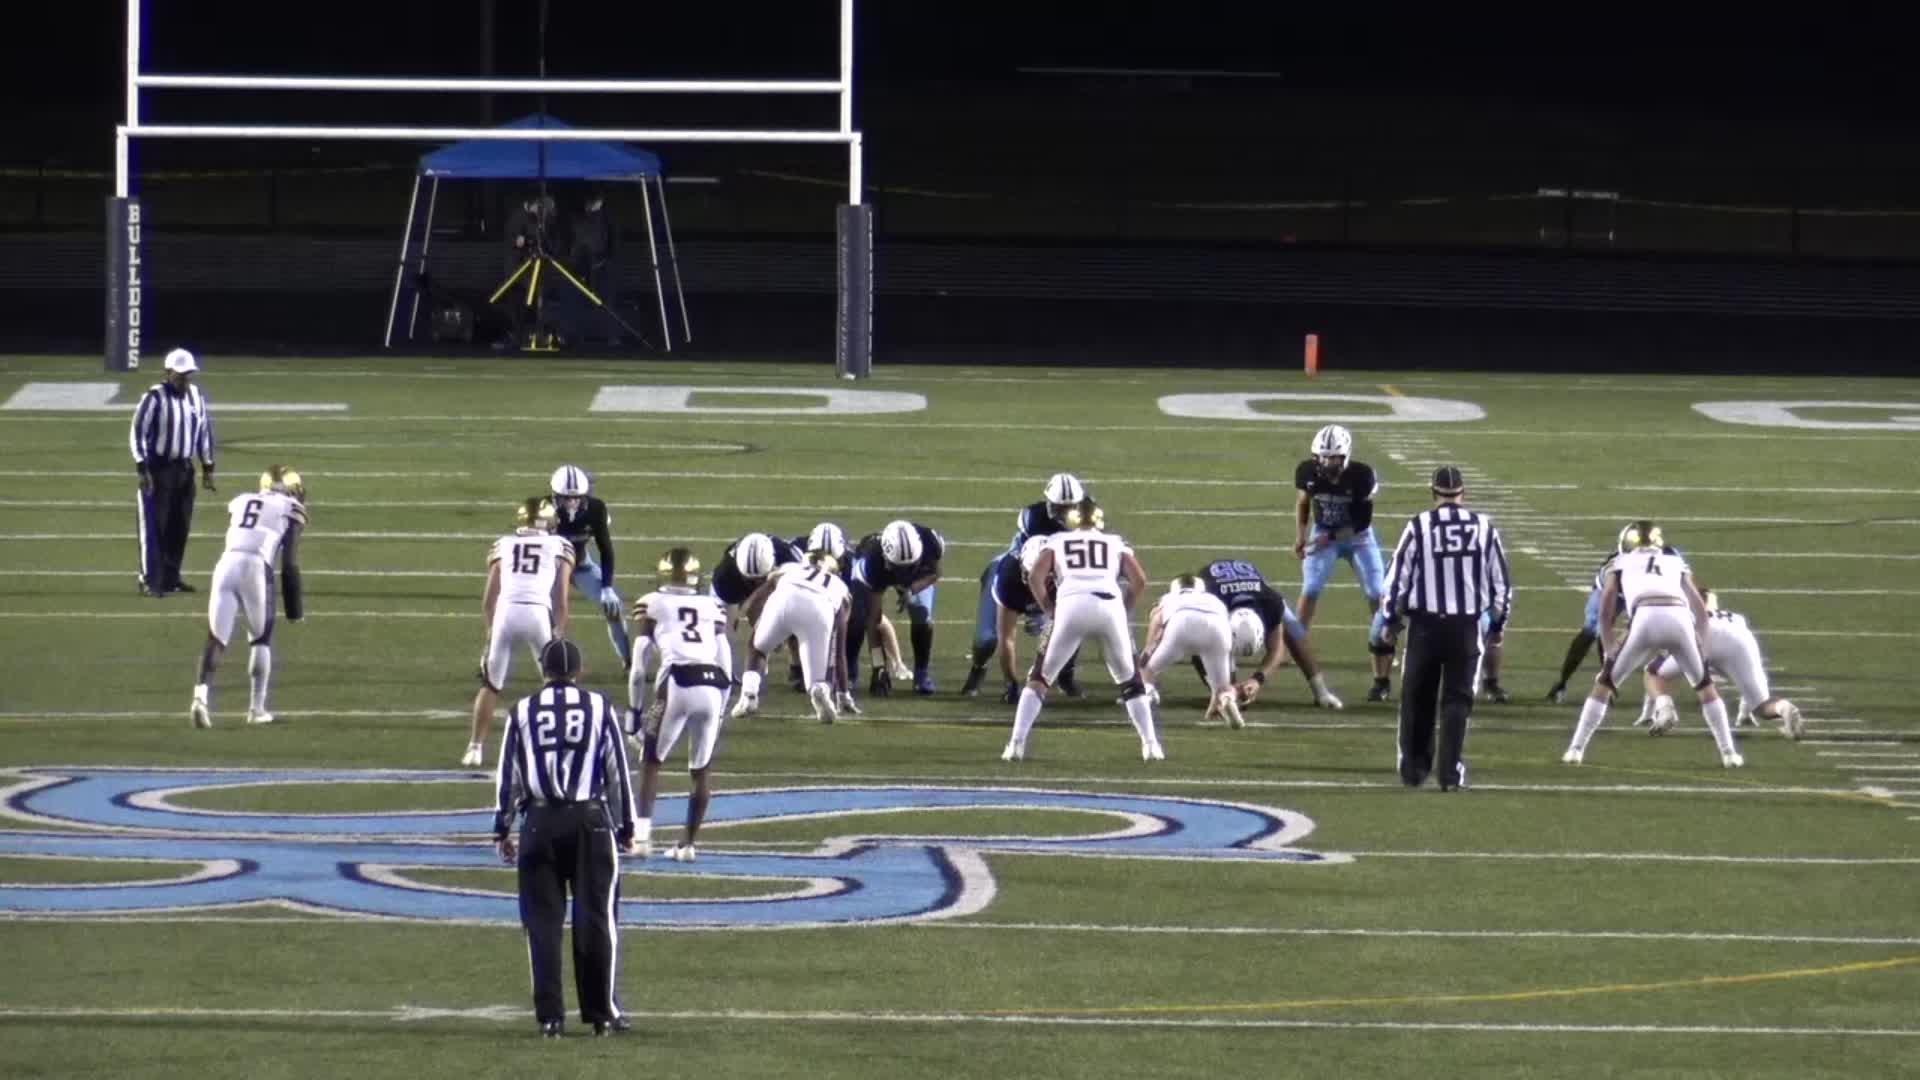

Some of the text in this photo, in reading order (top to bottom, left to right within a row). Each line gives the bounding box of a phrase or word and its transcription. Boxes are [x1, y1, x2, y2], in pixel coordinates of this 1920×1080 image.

[128, 204, 140, 369] BULLDOGS
[239, 499, 264, 529] 6
[1433, 524, 1479, 552] 157
[512, 543, 543, 575] 15
[1063, 539, 1108, 570] 50
[1645, 556, 1664, 577] 4
[678, 607, 703, 643] 3
[536, 709, 585, 746] 28
